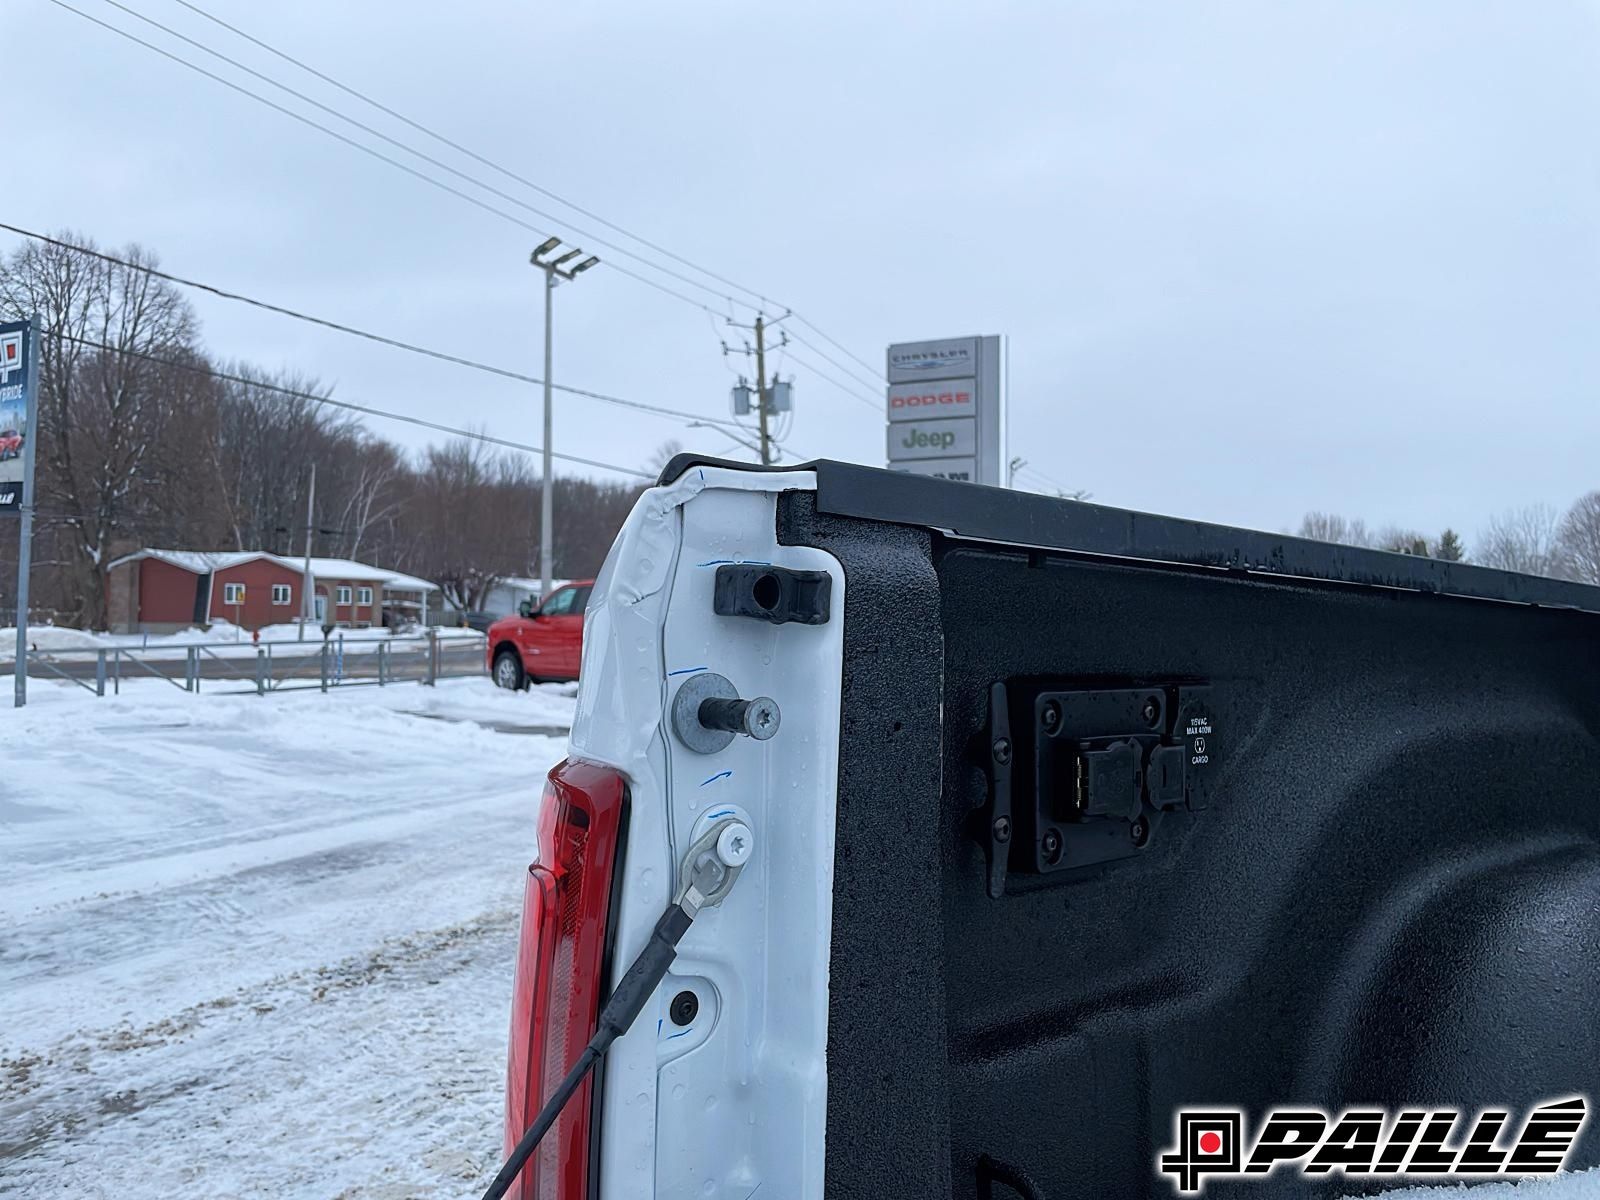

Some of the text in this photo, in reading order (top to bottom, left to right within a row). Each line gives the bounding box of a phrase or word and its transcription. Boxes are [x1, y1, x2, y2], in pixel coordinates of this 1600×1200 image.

[892, 350, 968, 362] CHRYSLER
[891, 392, 970, 409] DODGE
[902, 429, 955, 449] Jeep
[1186, 727, 1198, 735] MAX
[1191, 755, 1209, 765] CARGO
